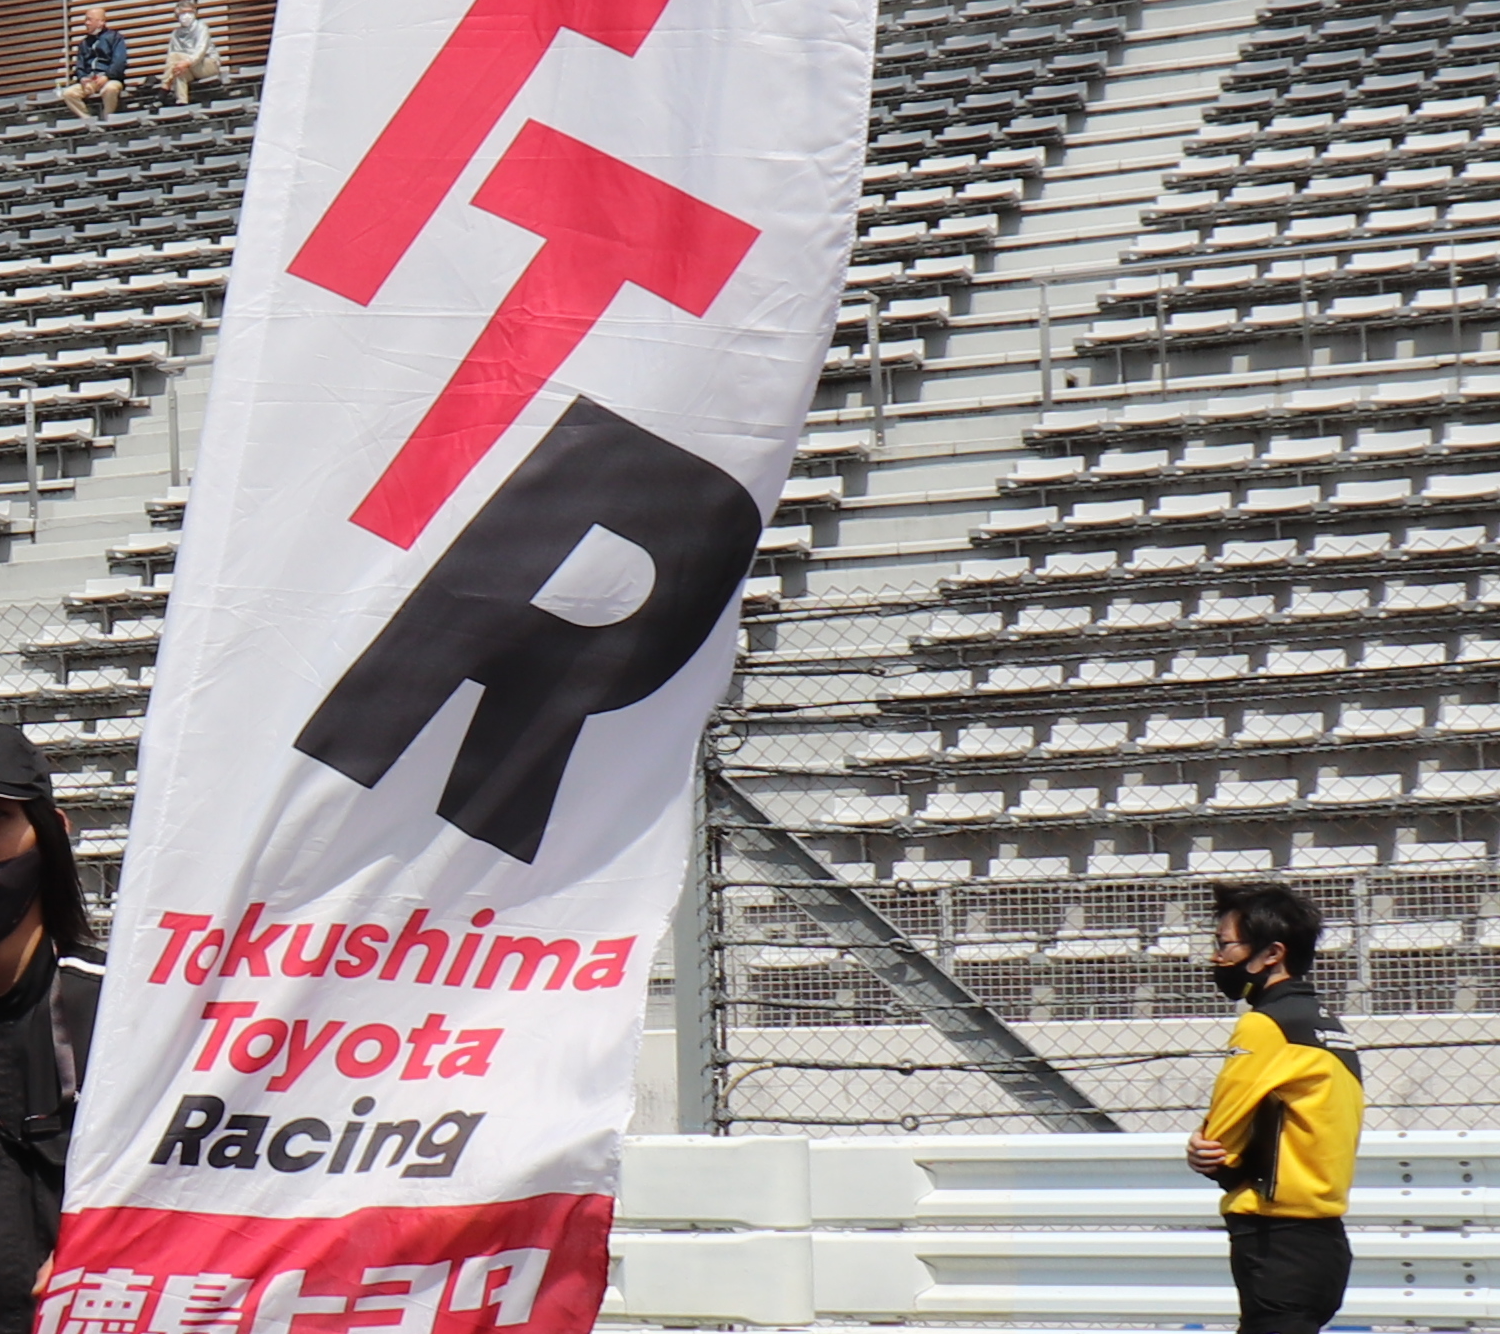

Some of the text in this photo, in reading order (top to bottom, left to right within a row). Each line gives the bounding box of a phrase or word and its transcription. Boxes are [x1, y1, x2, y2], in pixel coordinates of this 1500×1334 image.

[148, 903, 637, 992] Tokushima
[192, 1001, 504, 1091] Toyota
[150, 1094, 487, 1178] Racing
